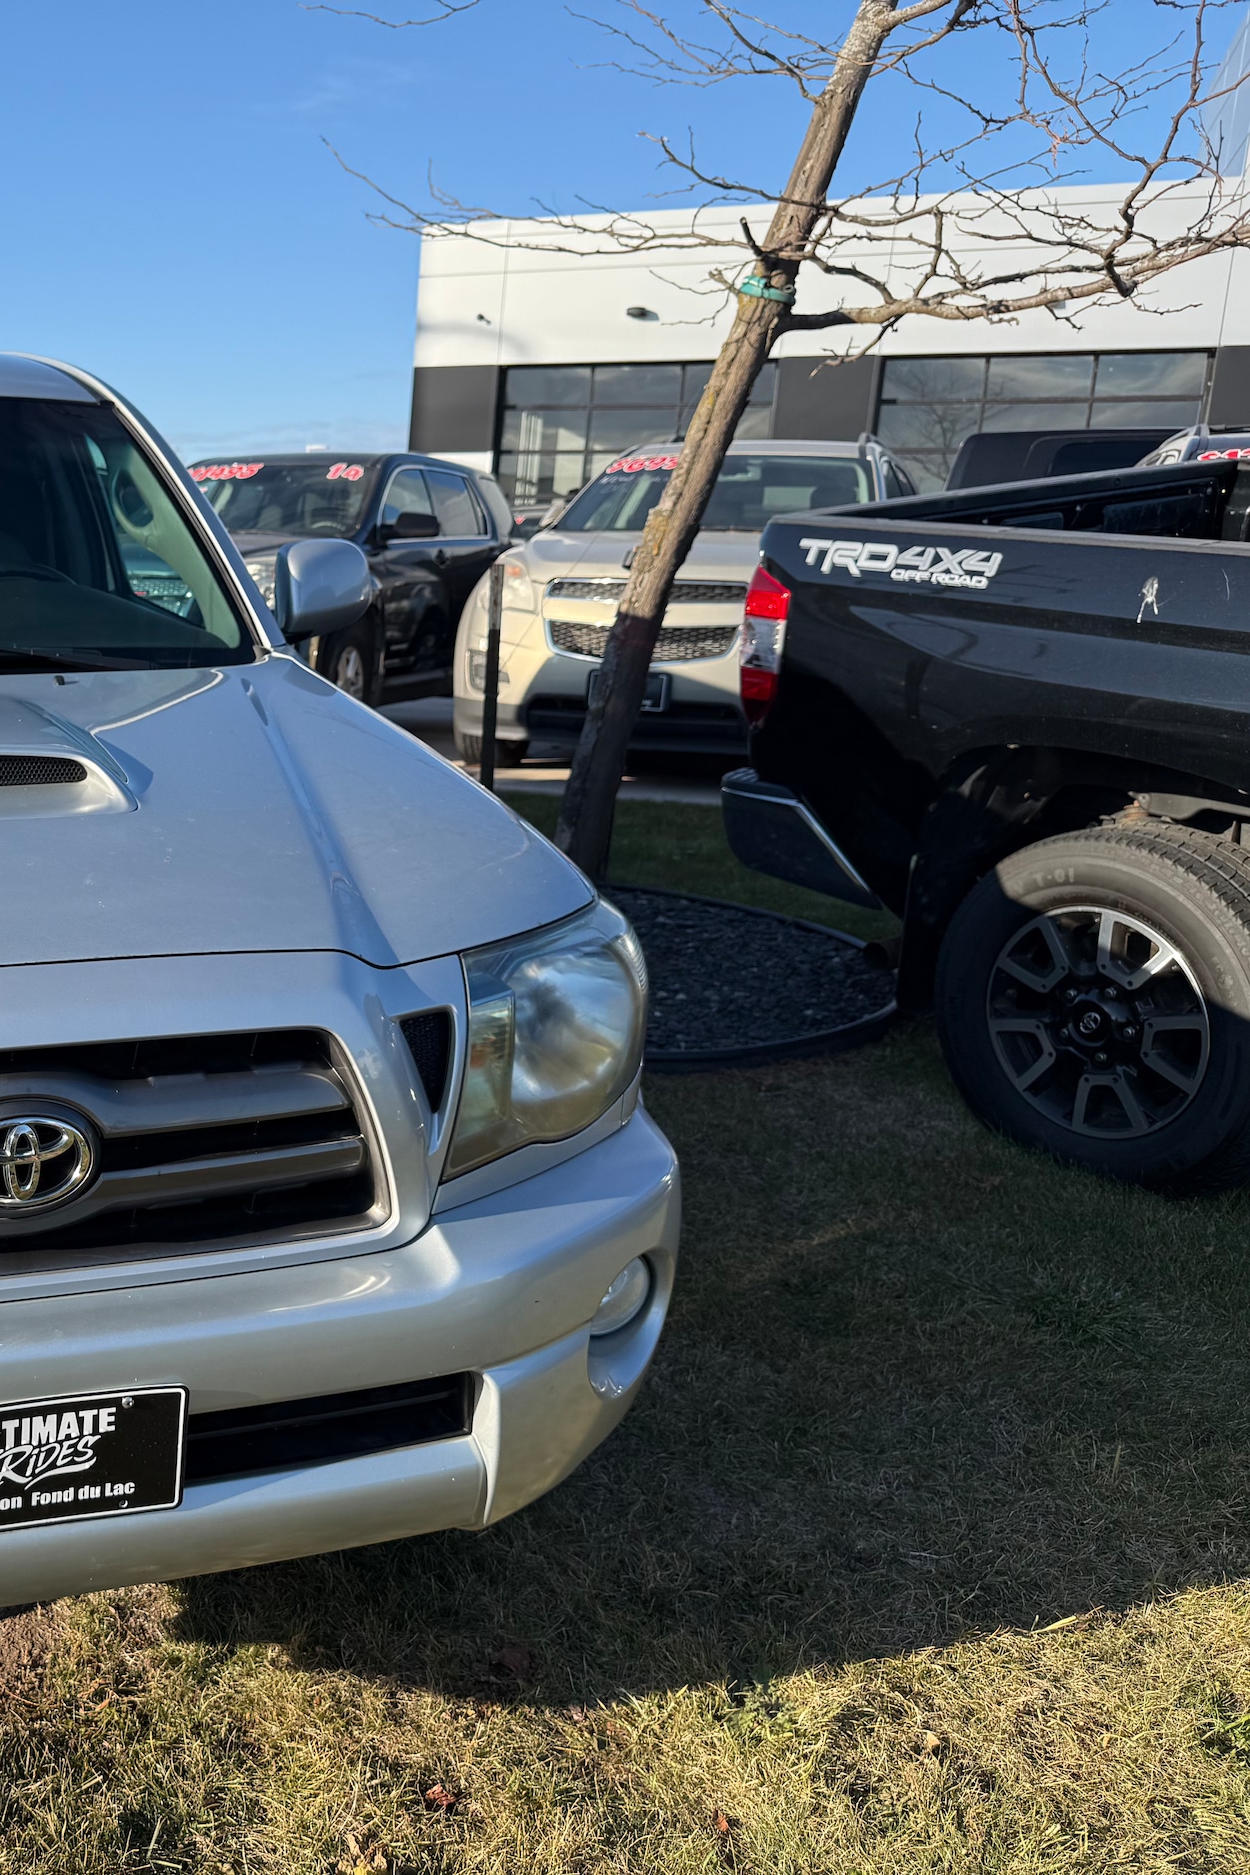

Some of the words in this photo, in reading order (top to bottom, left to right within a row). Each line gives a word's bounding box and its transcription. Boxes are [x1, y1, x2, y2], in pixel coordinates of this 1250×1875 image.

[799, 537, 899, 577] TRD
[930, 572, 989, 589] ROAD
[31, 1486, 75, 1507] Fond
[78, 1485, 101, 1500] du
[105, 1481, 136, 1496] Lac
